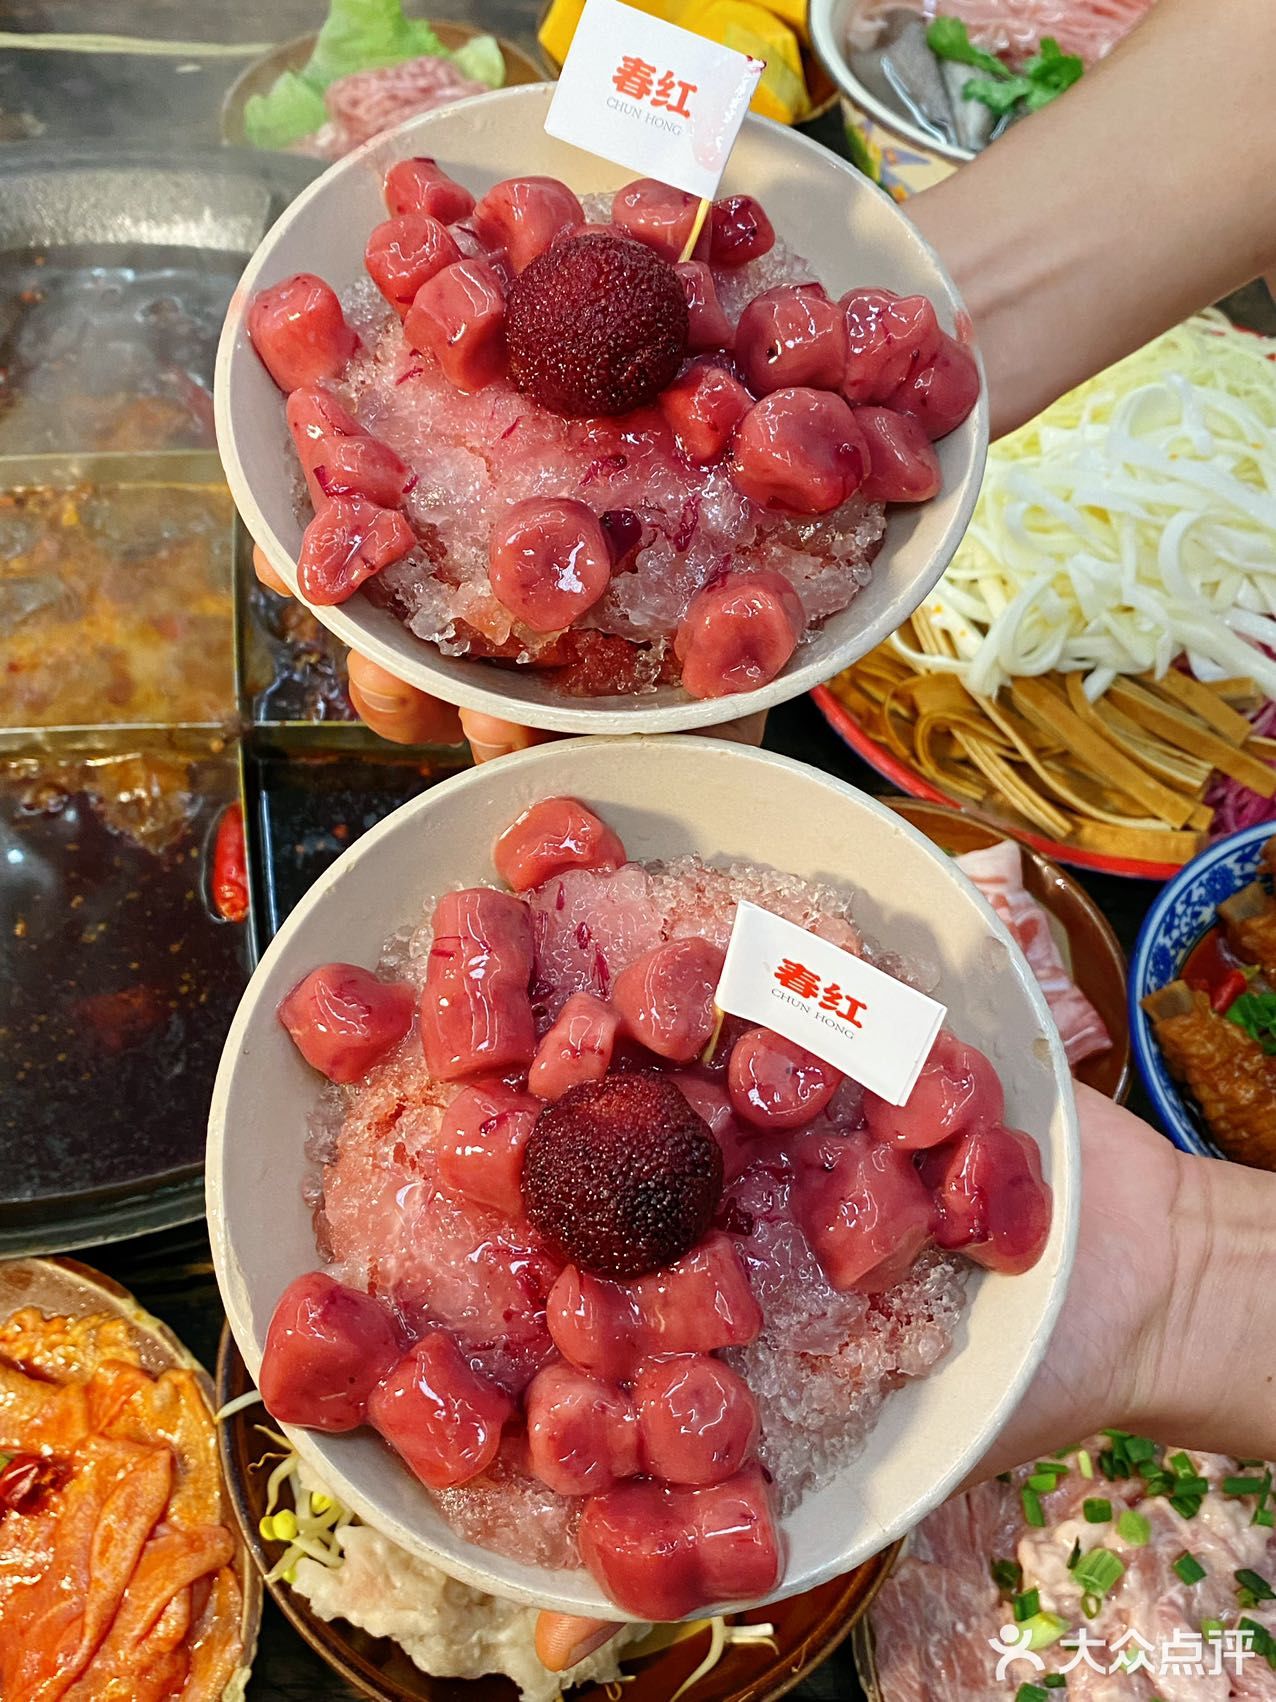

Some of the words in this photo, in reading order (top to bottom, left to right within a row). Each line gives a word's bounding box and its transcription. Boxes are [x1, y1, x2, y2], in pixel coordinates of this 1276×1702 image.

[606, 96, 642, 119] CHUN
[645, 113, 682, 136] HONG
[612, 55, 698, 119] 春红
[771, 988, 811, 1014] CHUN
[814, 1011, 855, 1040] HONG
[774, 958, 867, 1028] 春红
